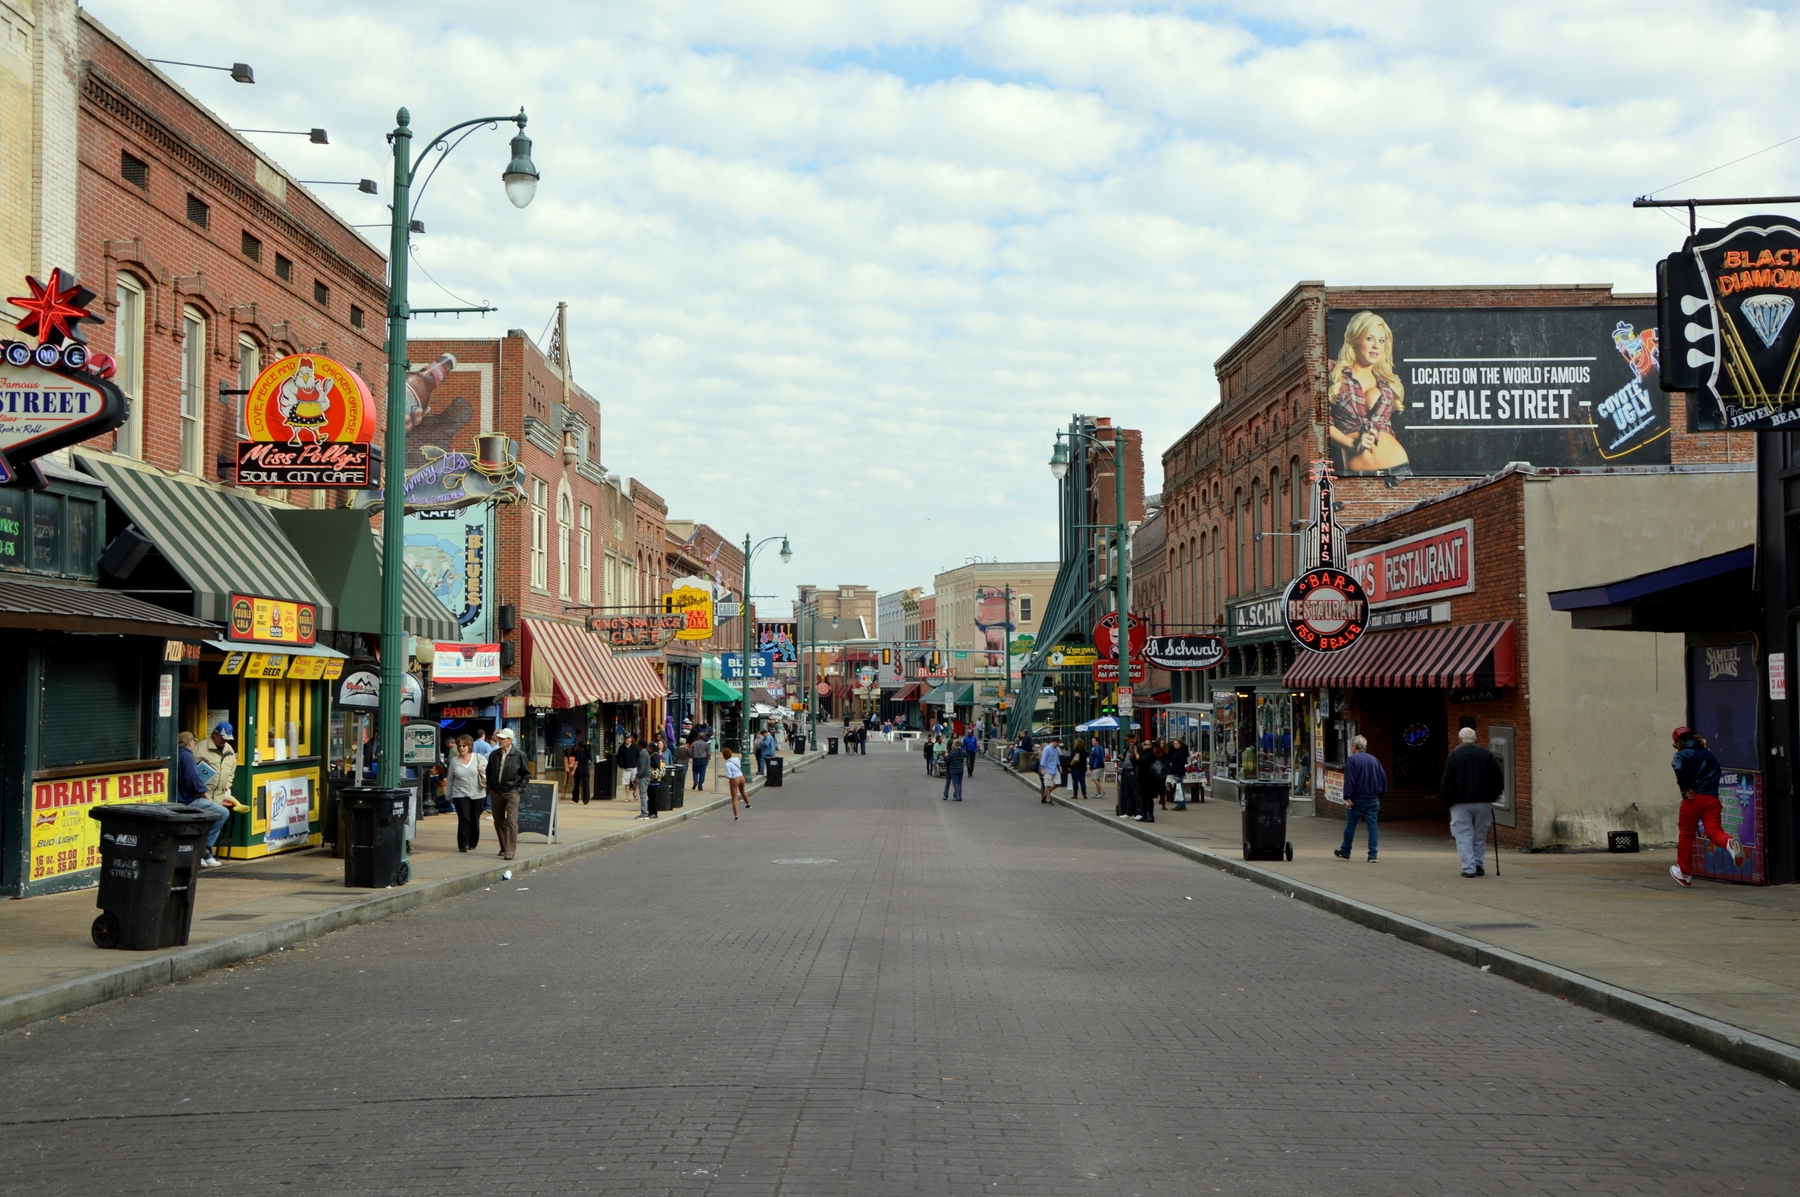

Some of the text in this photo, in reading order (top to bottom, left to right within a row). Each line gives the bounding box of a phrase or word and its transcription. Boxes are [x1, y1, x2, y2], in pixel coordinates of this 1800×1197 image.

[1411, 366, 1591, 385] LOCATED ON THE WORLD FAMOUS
[0, 391, 91, 414] TREET
[257, 373, 279, 402] PEACE
[277, 361, 296, 377] AND
[321, 363, 353, 396] CHICKEN
[346, 396, 358, 435] GREASE
[1430, 389, 1573, 420] BEALE STREET
[1597, 378, 1643, 419] COYOTE
[1612, 388, 1653, 431] UGLY
[1725, 404, 1744, 417] The
[1774, 403, 1784, 415] of
[22, 423, 47, 435] Roll
[240, 444, 297, 465] Miss
[240, 470, 365, 482] SOUL CITY CAFE
[1321, 488, 1331, 562] FLYNN'S
[467, 534, 482, 606] BLUES
[1385, 537, 1463, 594] RESTAURANT
[1308, 572, 1346, 590] BAR
[234, 608, 252, 619] DOUBLE
[685, 609, 706, 619] TAP
[718, 603, 739, 615] CARGO
[1288, 599, 1364, 621] RESTAURANT
[236, 619, 249, 629] COLA
[592, 616, 680, 630] KING'S PALACE
[611, 630, 661, 643] CAFE
[1319, 623, 1361, 649] BEALE
[1146, 638, 1224, 656] A. Schwab
[728, 657, 766, 668] BLES
[1706, 647, 1741, 666] SAMUEL
[262, 667, 281, 677] BEER
[732, 667, 762, 677] HLL
[1709, 661, 1738, 680] ADAMS
[1771, 680, 1786, 689] 3 AM
[443, 706, 475, 718] PATIO
[35, 771, 165, 810] DRAFT BEER
[61, 817, 82, 828] ULTRA
[37, 834, 79, 848] BUD LIGHT
[36, 855, 44, 866] 16
[57, 848, 78, 861] $3.00
[87, 845, 95, 855] 16
[86, 855, 95, 866] 32
[34, 867, 44, 878] 32
[57, 860, 78, 873] $5.00
